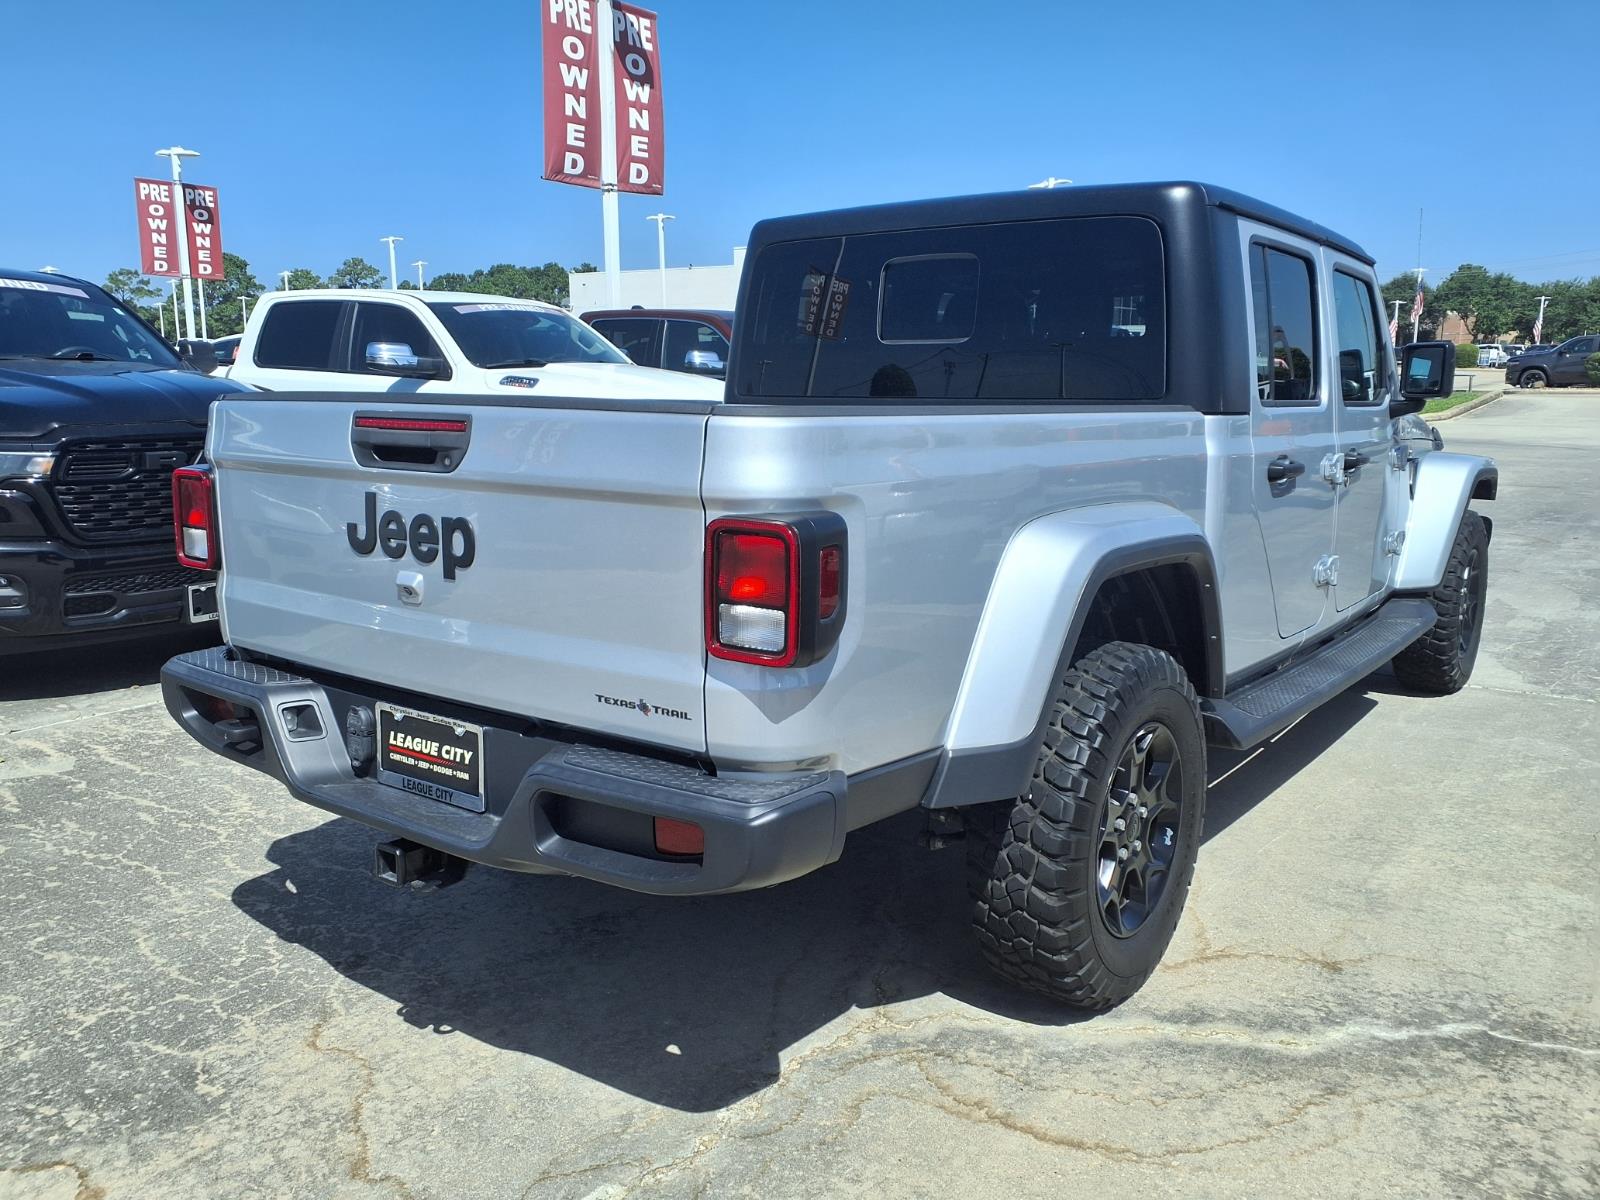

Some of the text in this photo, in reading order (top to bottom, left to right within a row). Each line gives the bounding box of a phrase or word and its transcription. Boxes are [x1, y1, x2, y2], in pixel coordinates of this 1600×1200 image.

[551, 0, 592, 34] PRE
[613, 9, 653, 51] PRE
[559, 35, 588, 176] OWNED
[623, 53, 650, 185] OWNED
[139, 182, 170, 202] PRE
[184, 188, 215, 208] PRE
[147, 204, 168, 272] OWNED
[192, 208, 213, 274] OWNED
[347, 491, 475, 580] Jeep
[595, 694, 693, 721] TEXAS TRAIL
[389, 731, 440, 757] LEAGUE
[441, 744, 473, 765] CITY
[389, 752, 470, 781] CHRYSLER JEEP DODGE RAM
[402, 777, 454, 803] LEAGUE CITY
